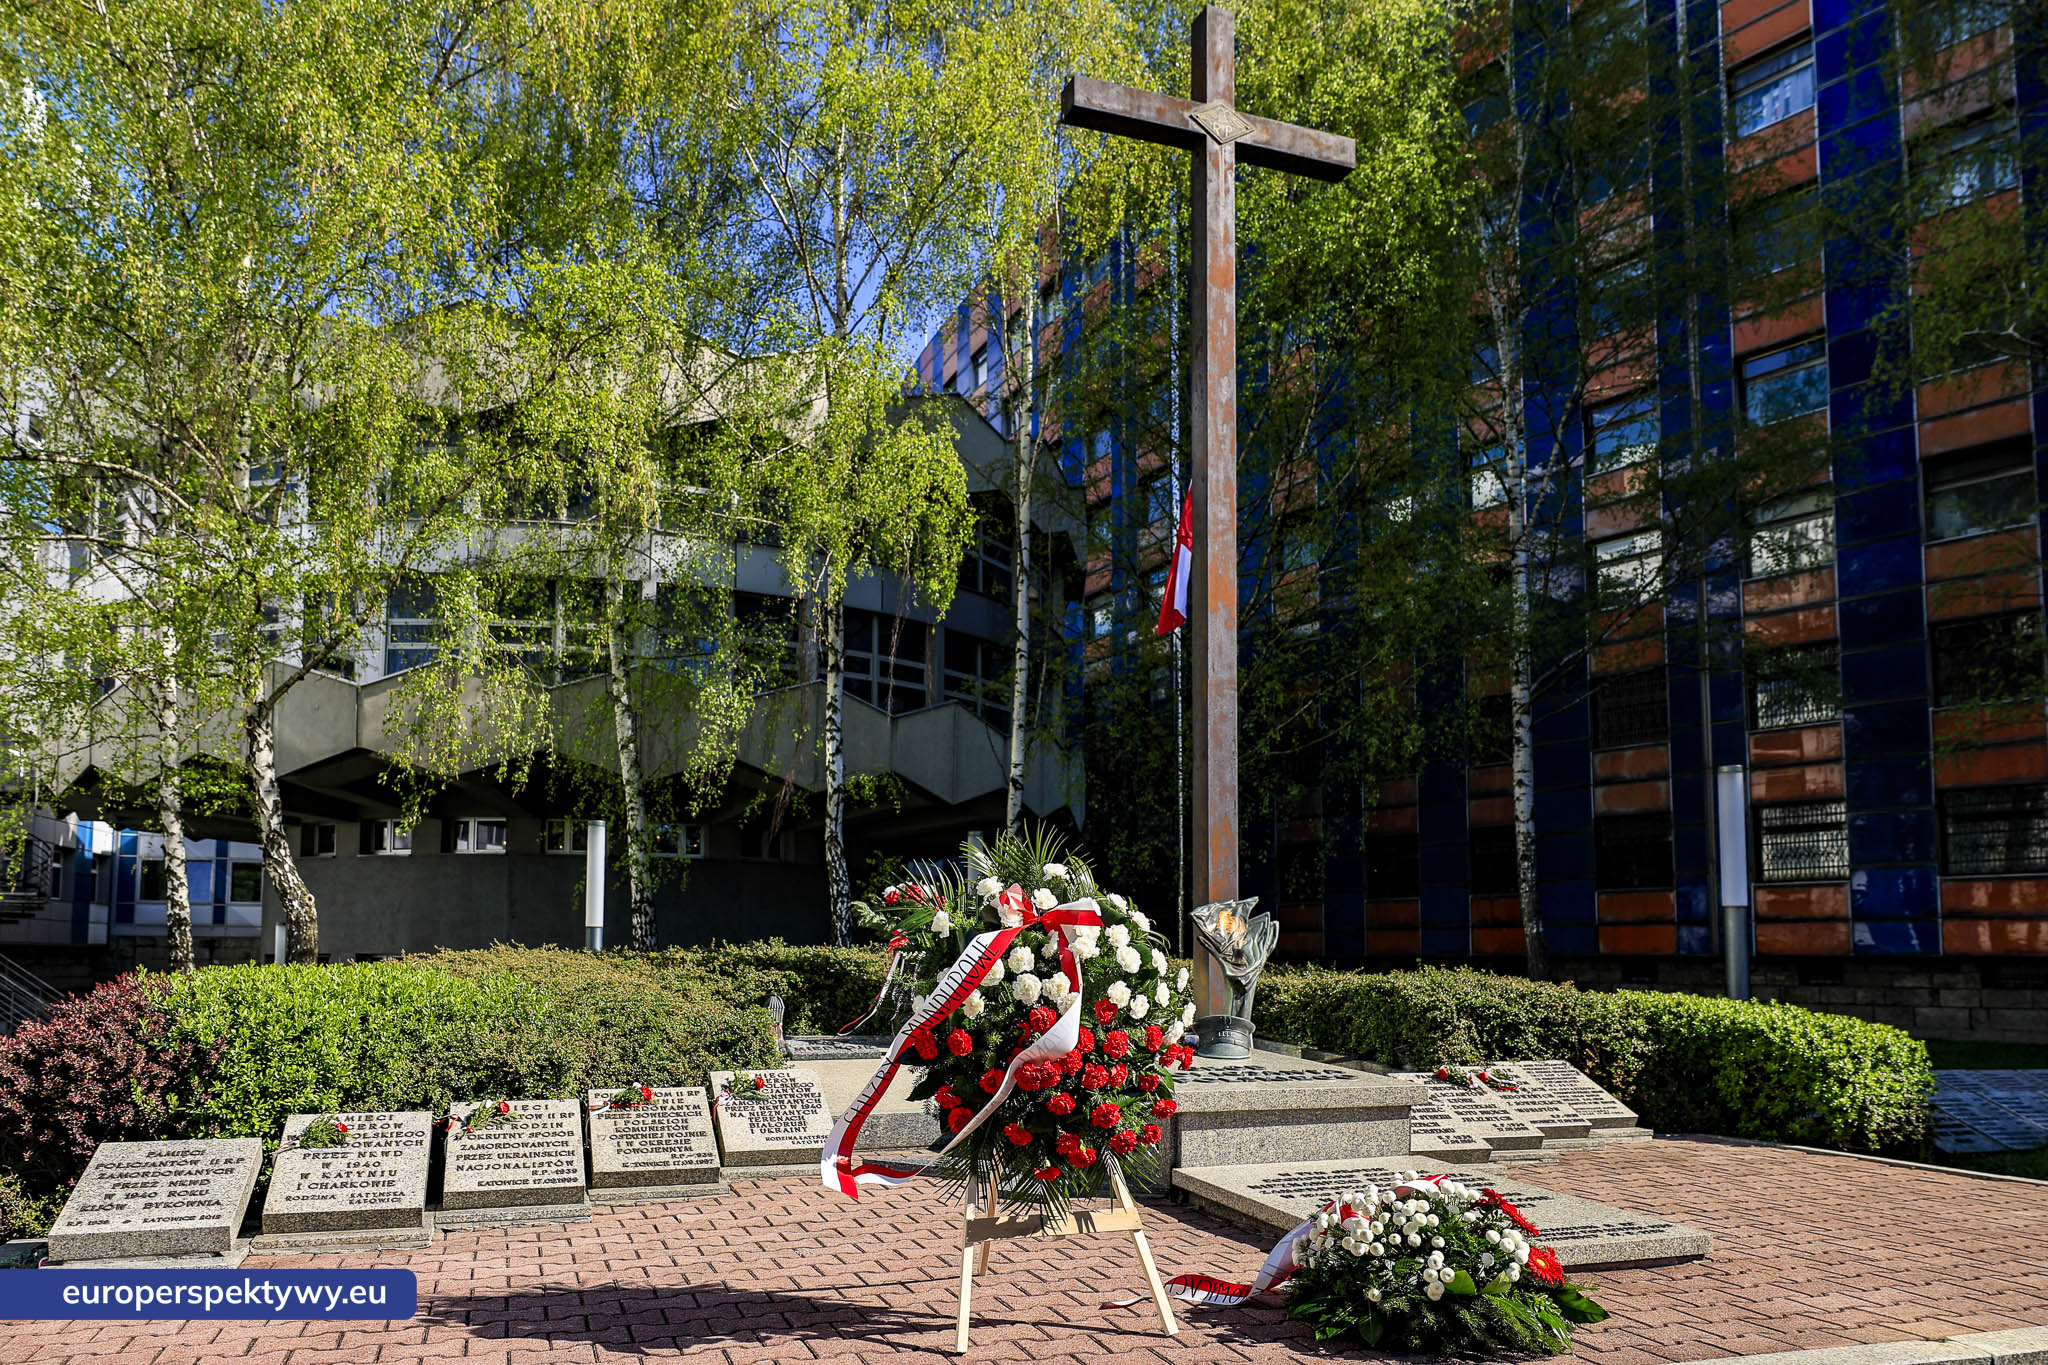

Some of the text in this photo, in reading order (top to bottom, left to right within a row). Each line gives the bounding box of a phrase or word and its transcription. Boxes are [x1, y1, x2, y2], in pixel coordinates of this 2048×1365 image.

[900, 935, 1000, 1039] MUNDUROWE
[635, 1111, 703, 1119] SOWIECKICH
[748, 1109, 818, 1117] NIEZNANYCH
[623, 1118, 689, 1126] POLSKICH
[748, 1115, 806, 1123] TERENACH
[511, 1122, 564, 1130] RODZIN
[353, 1130, 426, 1139] OLSKIEGO
[528, 1130, 575, 1139] SPOSÓB
[609, 1133, 665, 1141] OSTATNIEJ
[460, 1141, 570, 1151] ZAMORDOWANYCH
[616, 1146, 694, 1155] POWOJENNYM
[302, 1150, 403, 1160] PRZEZ NKWD
[456, 1153, 493, 1161] PRZEZ
[456, 1159, 575, 1172] NACJONALISTÓW
[97, 1167, 235, 1180] ZAMORDOWANYCH
[321, 1170, 398, 1179] KATYNIU
[111, 1178, 211, 1190] PRZEZ NKWD
[307, 1180, 396, 1190] CHARKOWIE
[477, 1179, 530, 1187] KATOWICE
[124, 1191, 158, 1200] 1940
[167, 1189, 211, 1198] ROKU
[285, 1194, 337, 1202] RODZINA
[142, 1199, 222, 1210] BYKOWNIA
[142, 1215, 196, 1224] KATOWICE
